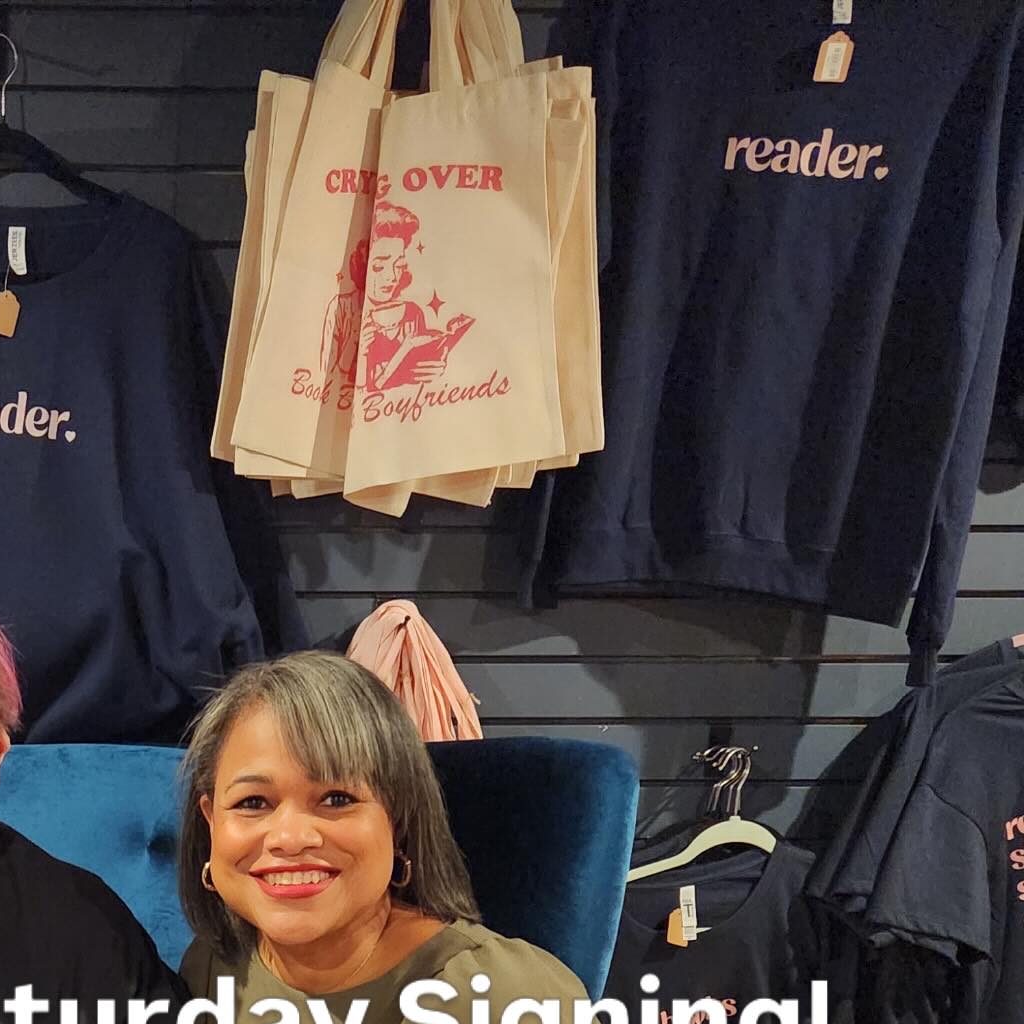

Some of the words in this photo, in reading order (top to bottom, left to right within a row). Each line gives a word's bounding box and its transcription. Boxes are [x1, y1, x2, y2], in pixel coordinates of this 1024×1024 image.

[402, 165, 504, 192] OVER
[291, 368, 334, 407] Book
[363, 369, 511, 423] Boyfriends
